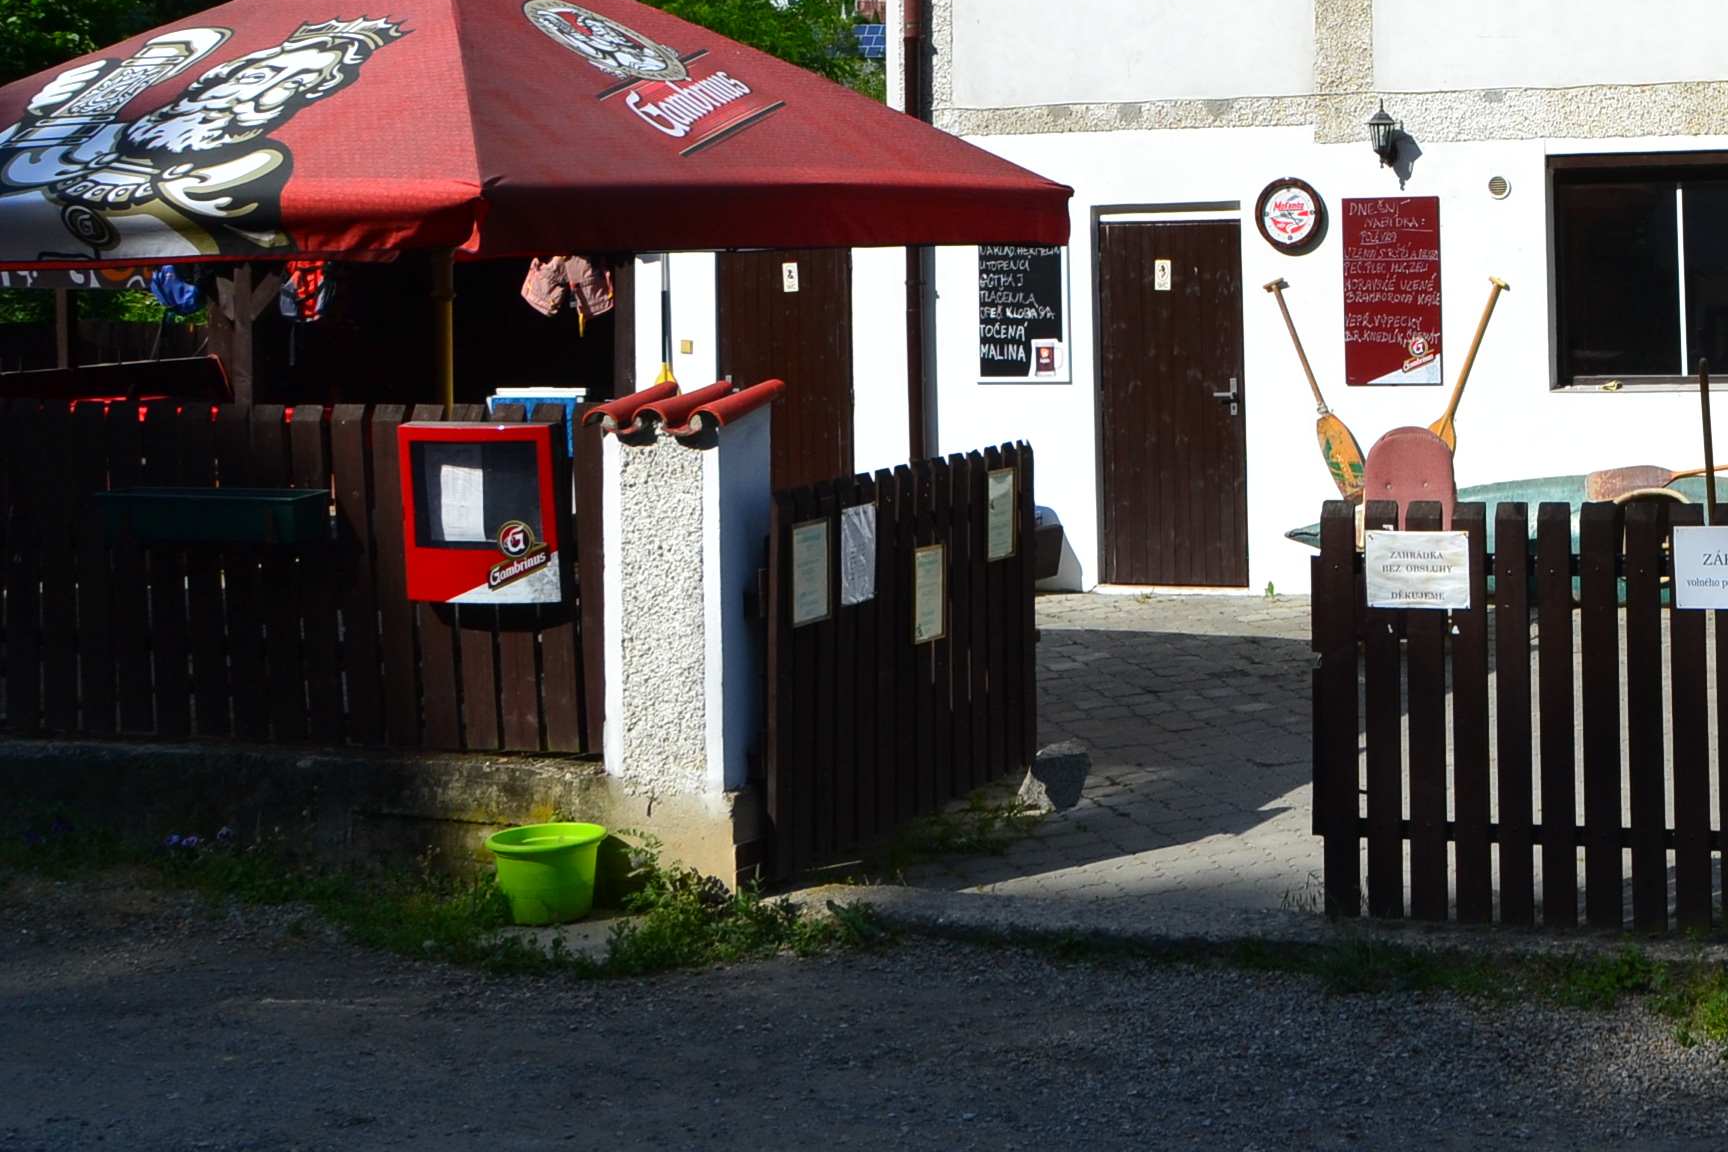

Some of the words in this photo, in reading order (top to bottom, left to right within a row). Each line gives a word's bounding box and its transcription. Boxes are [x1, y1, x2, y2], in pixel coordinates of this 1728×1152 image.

[625, 70, 752, 138] Gambrinus
[980, 343, 1027, 362] MALINA
[1390, 551, 1444, 560] ZAHRÁDKA
[488, 550, 547, 586] Gambrinus
[1382, 564, 1402, 573] BEZ
[1406, 564, 1453, 573] OBSLUHY
[1686, 578, 1720, 587] volného
